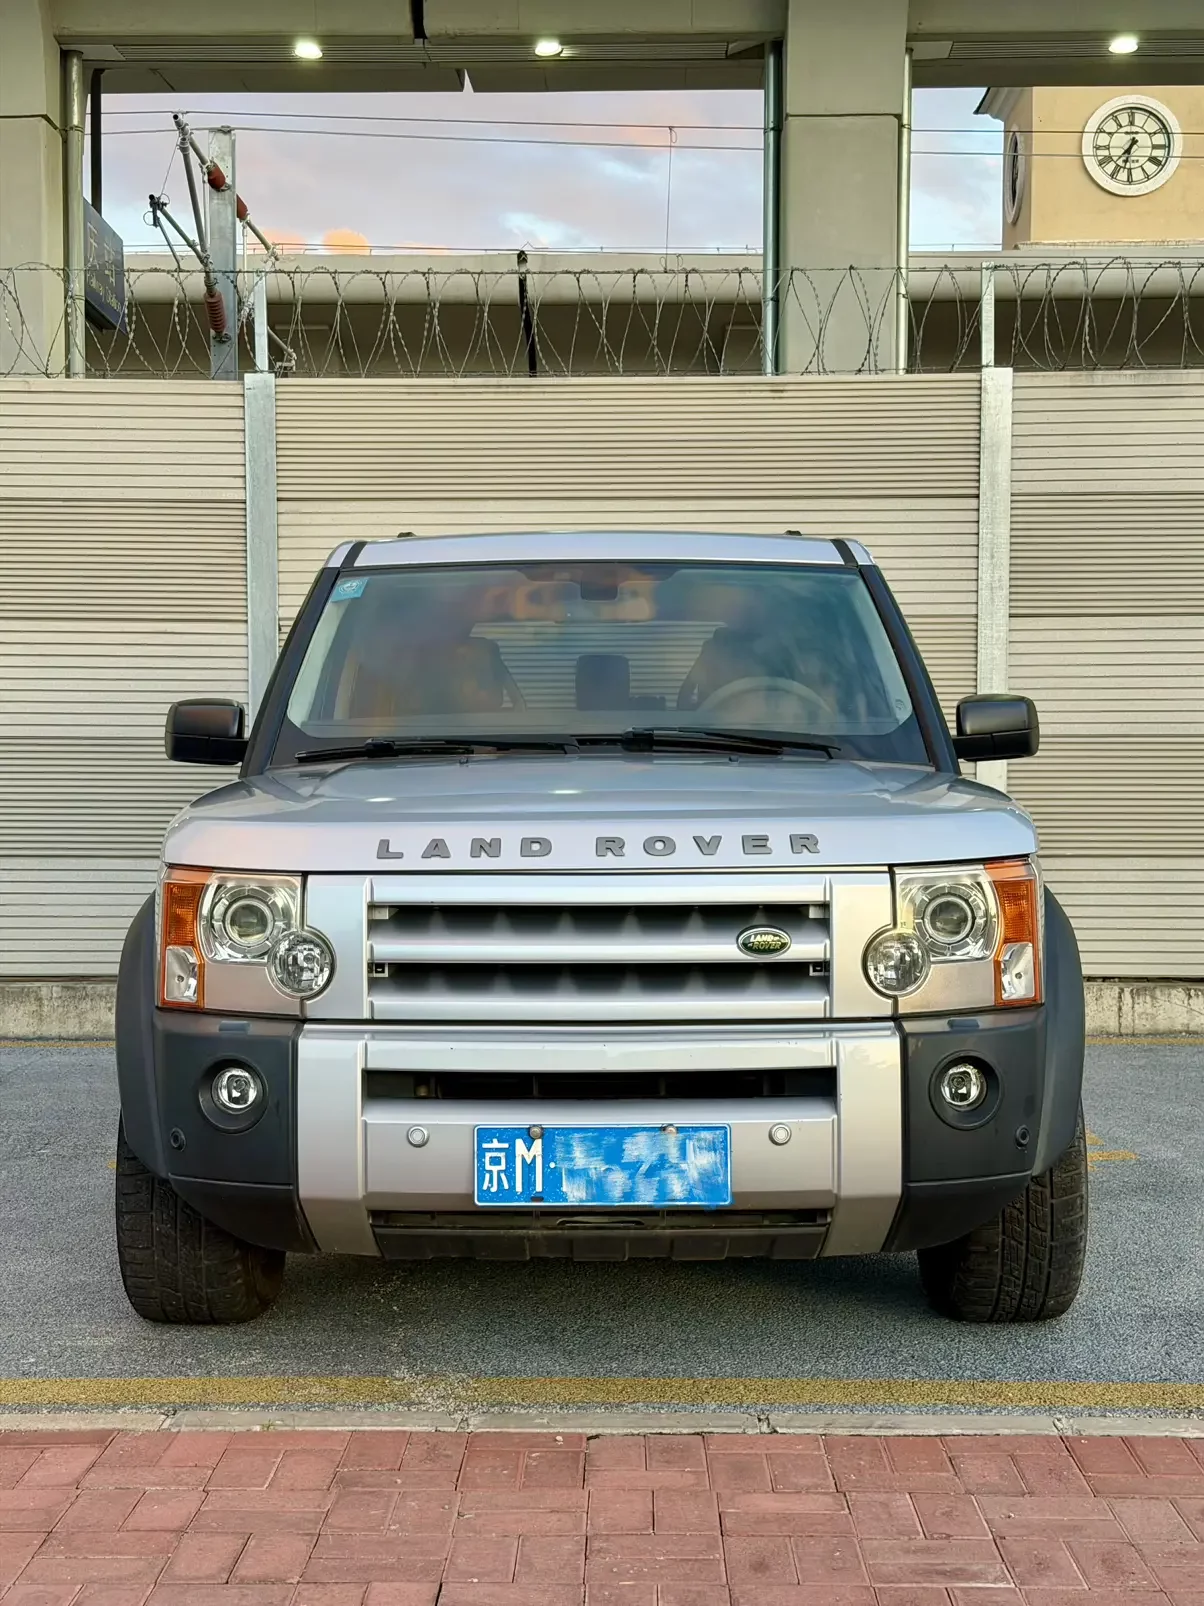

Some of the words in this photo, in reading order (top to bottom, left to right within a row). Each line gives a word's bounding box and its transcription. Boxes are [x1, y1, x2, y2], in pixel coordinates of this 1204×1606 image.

[376, 837, 553, 859] LAND
[595, 833, 821, 857] ROVER
[750, 934, 774, 942] LAND
[752, 941, 782, 950] ROVER
